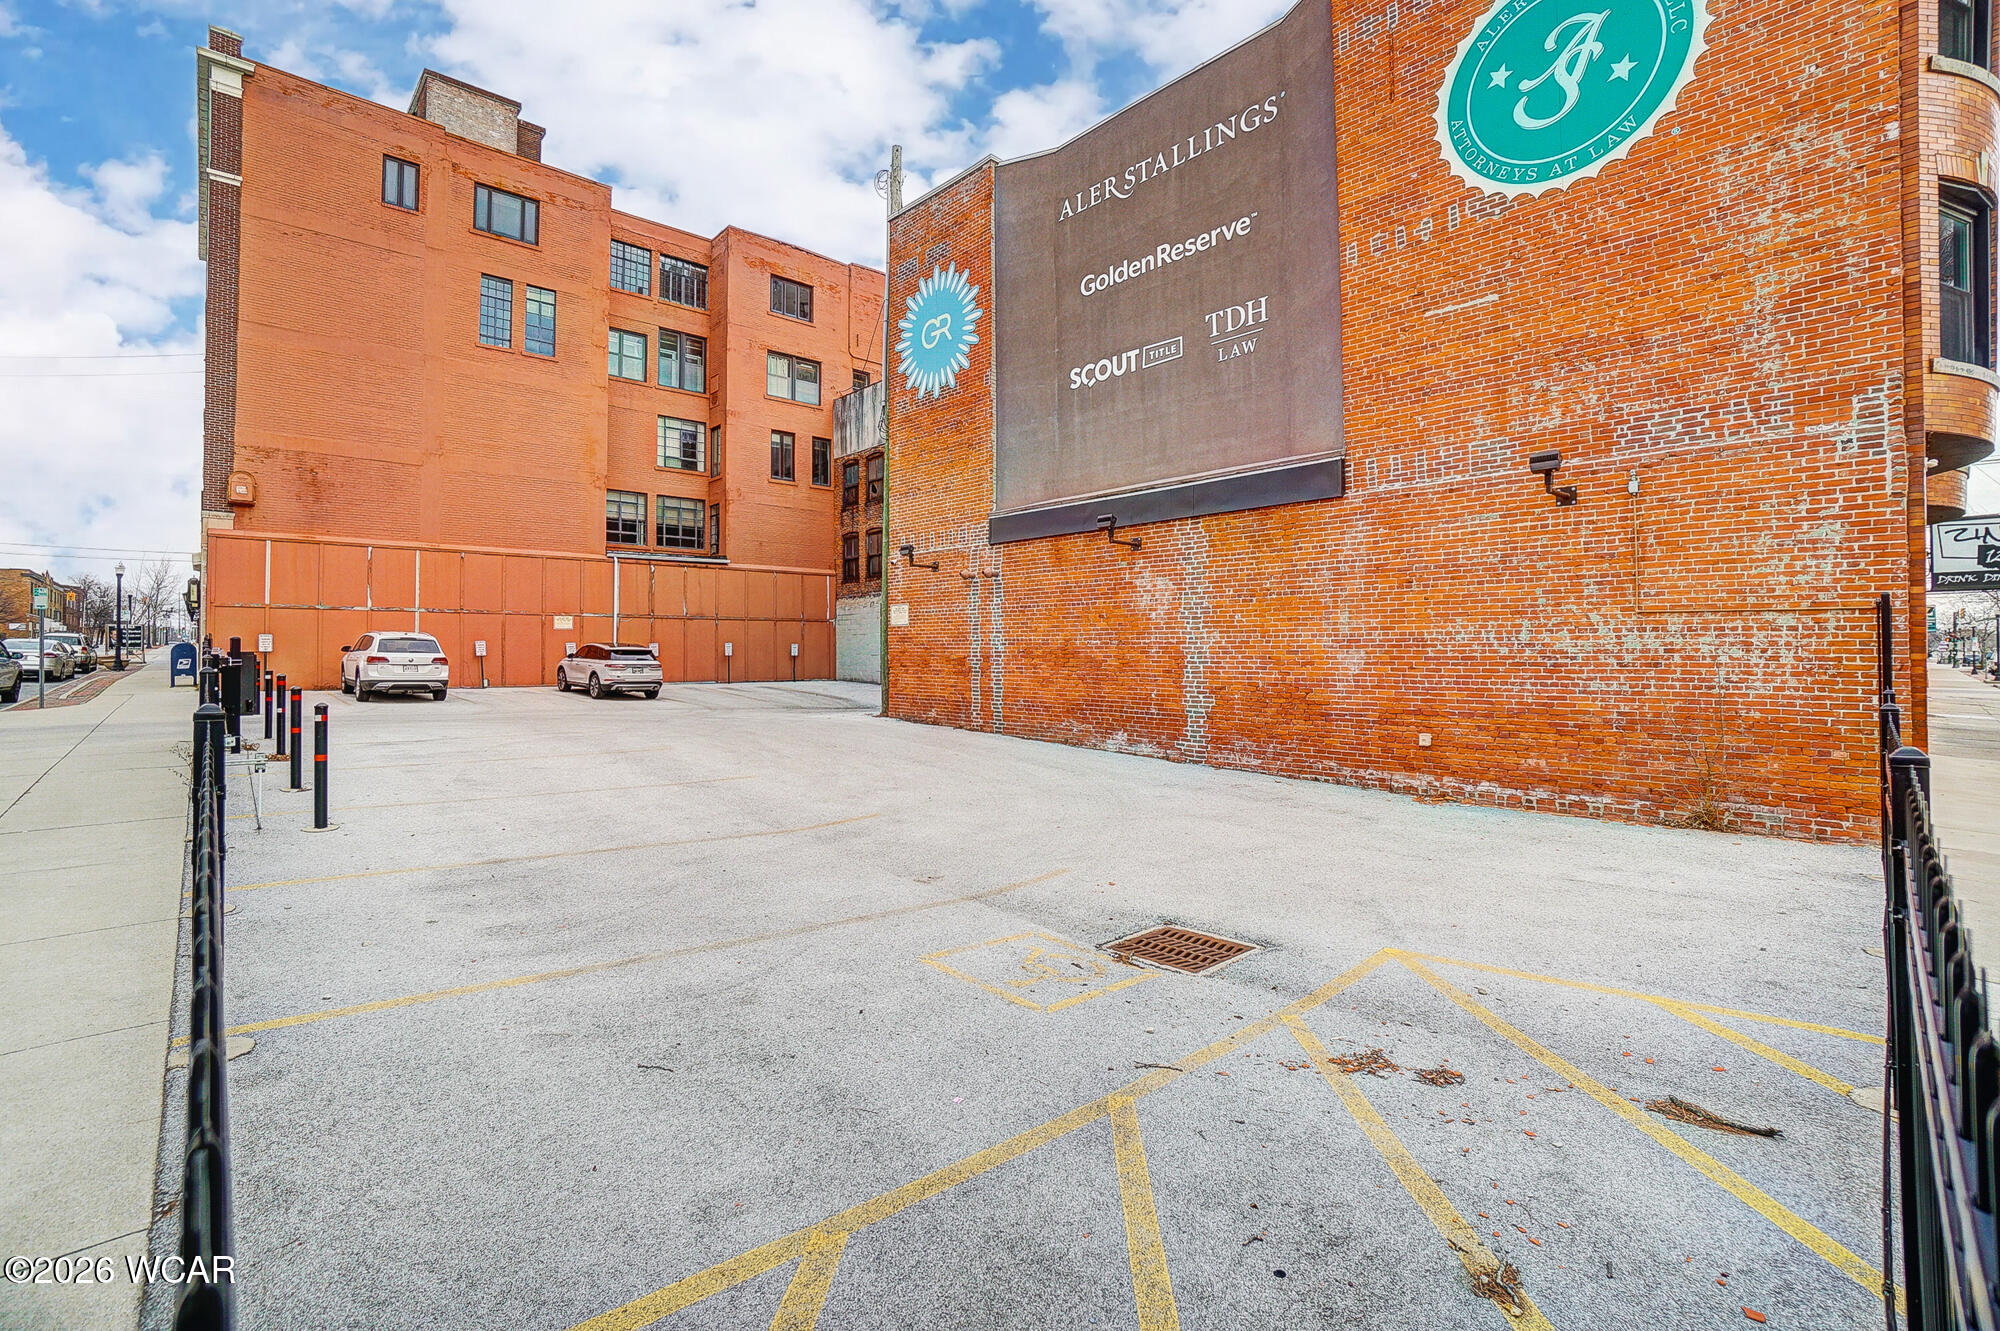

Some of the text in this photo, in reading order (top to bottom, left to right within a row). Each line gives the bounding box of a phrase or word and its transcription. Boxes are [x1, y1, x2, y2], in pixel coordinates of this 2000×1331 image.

[1451, 114, 1640, 182] ATTORNEYS AT LAW
[1204, 295, 1270, 339] TDH
[1069, 343, 1178, 390] SCOUT TITLE
[1217, 337, 1258, 363] LAW
[1936, 573, 1979, 585] DRINK
